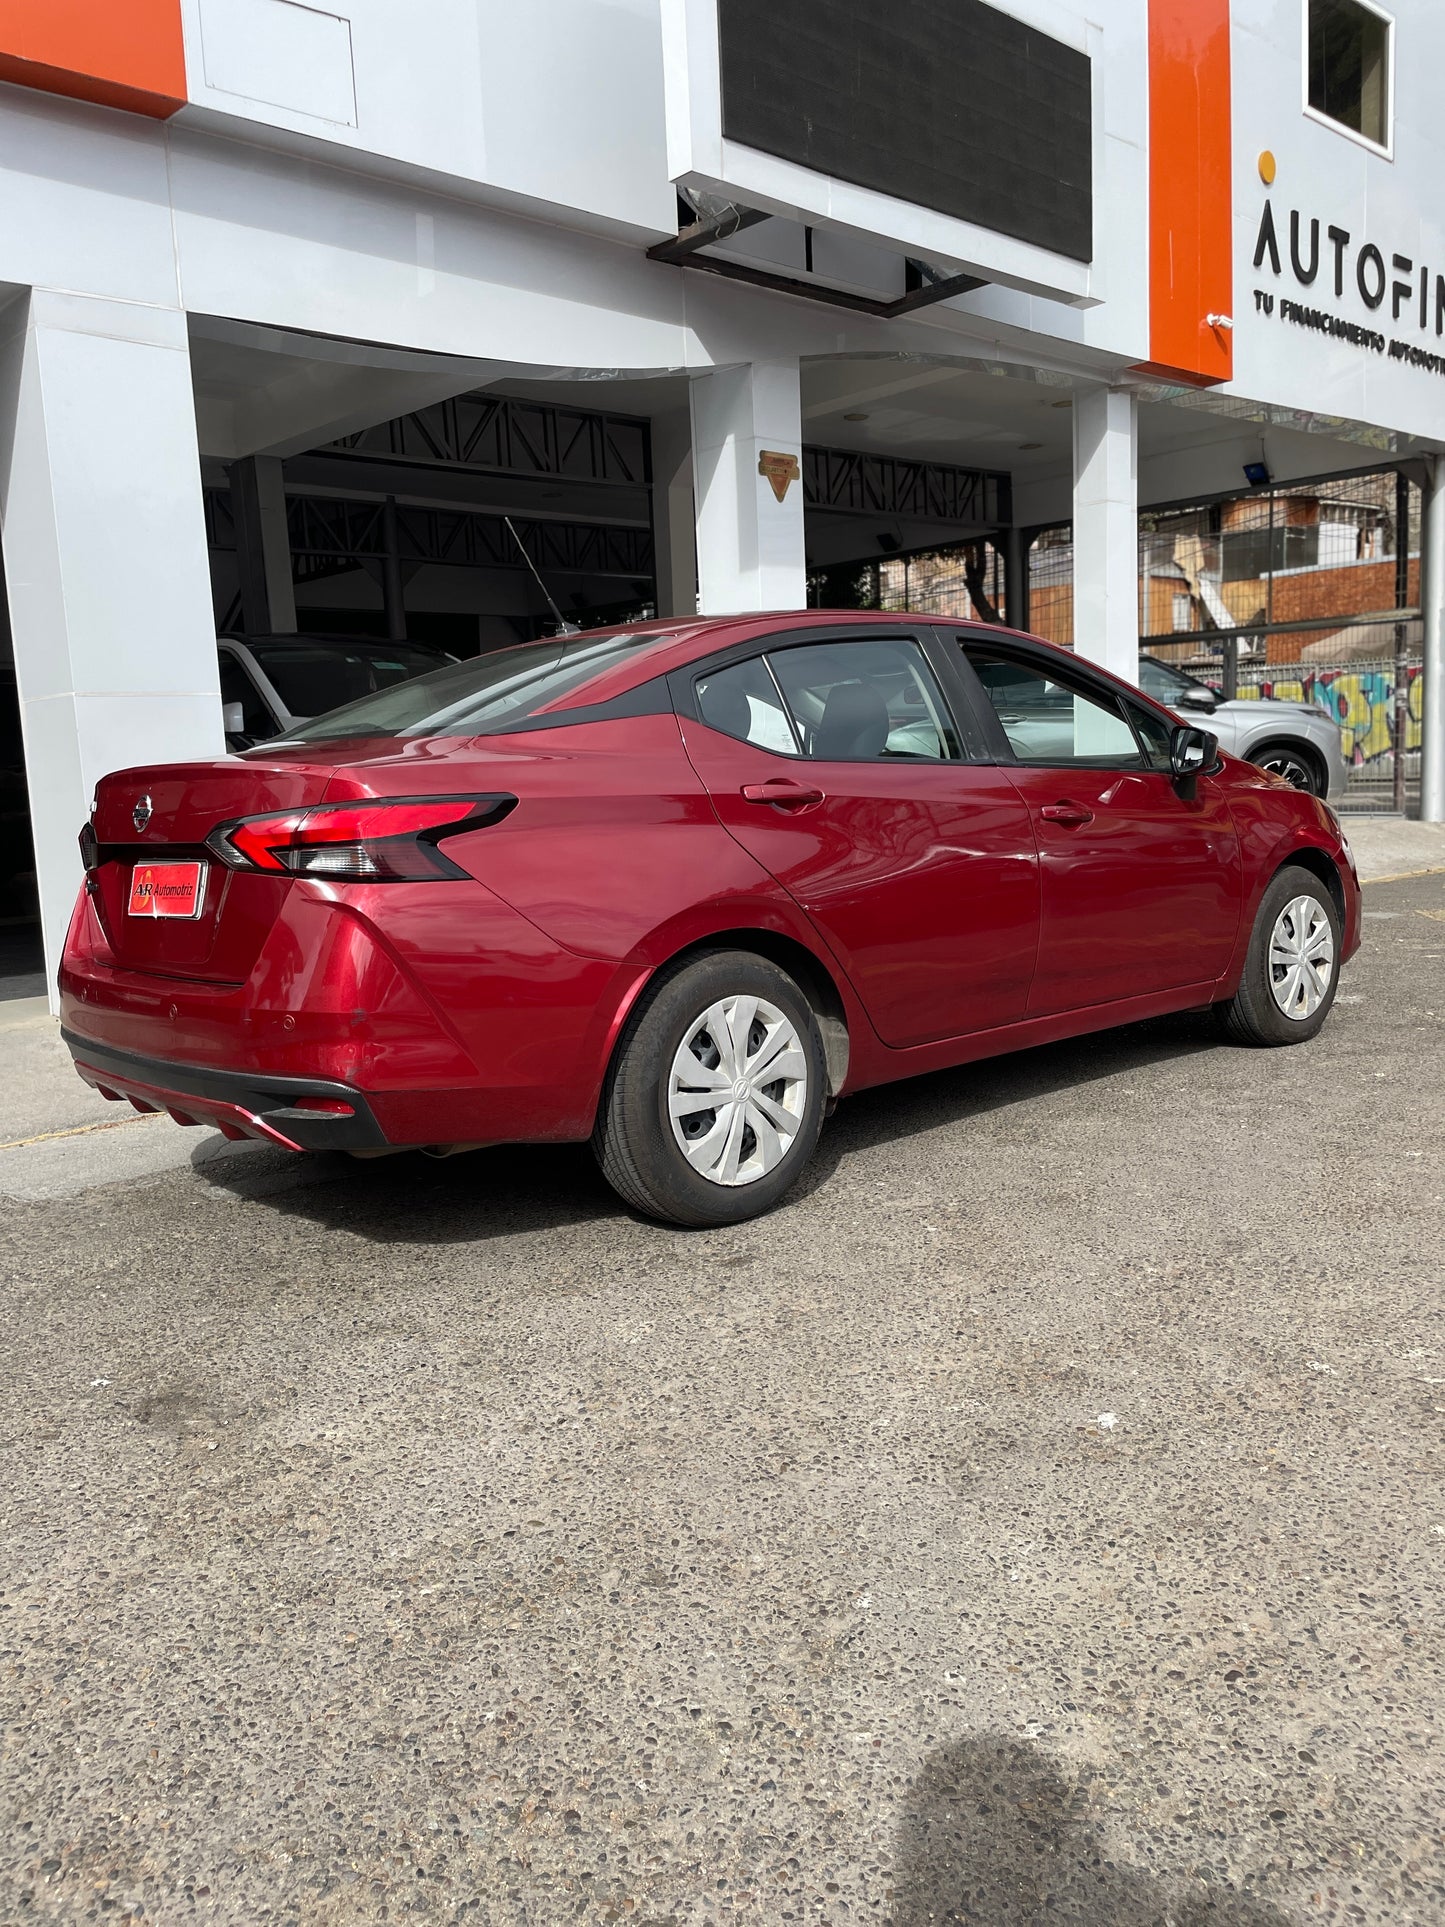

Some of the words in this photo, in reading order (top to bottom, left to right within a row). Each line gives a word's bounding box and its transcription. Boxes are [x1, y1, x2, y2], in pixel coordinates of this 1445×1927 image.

[1254, 290, 1274, 314] TU
[1280, 299, 1385, 352] FINANCIAMIENTO
[154, 883, 193, 896] Automotriz
